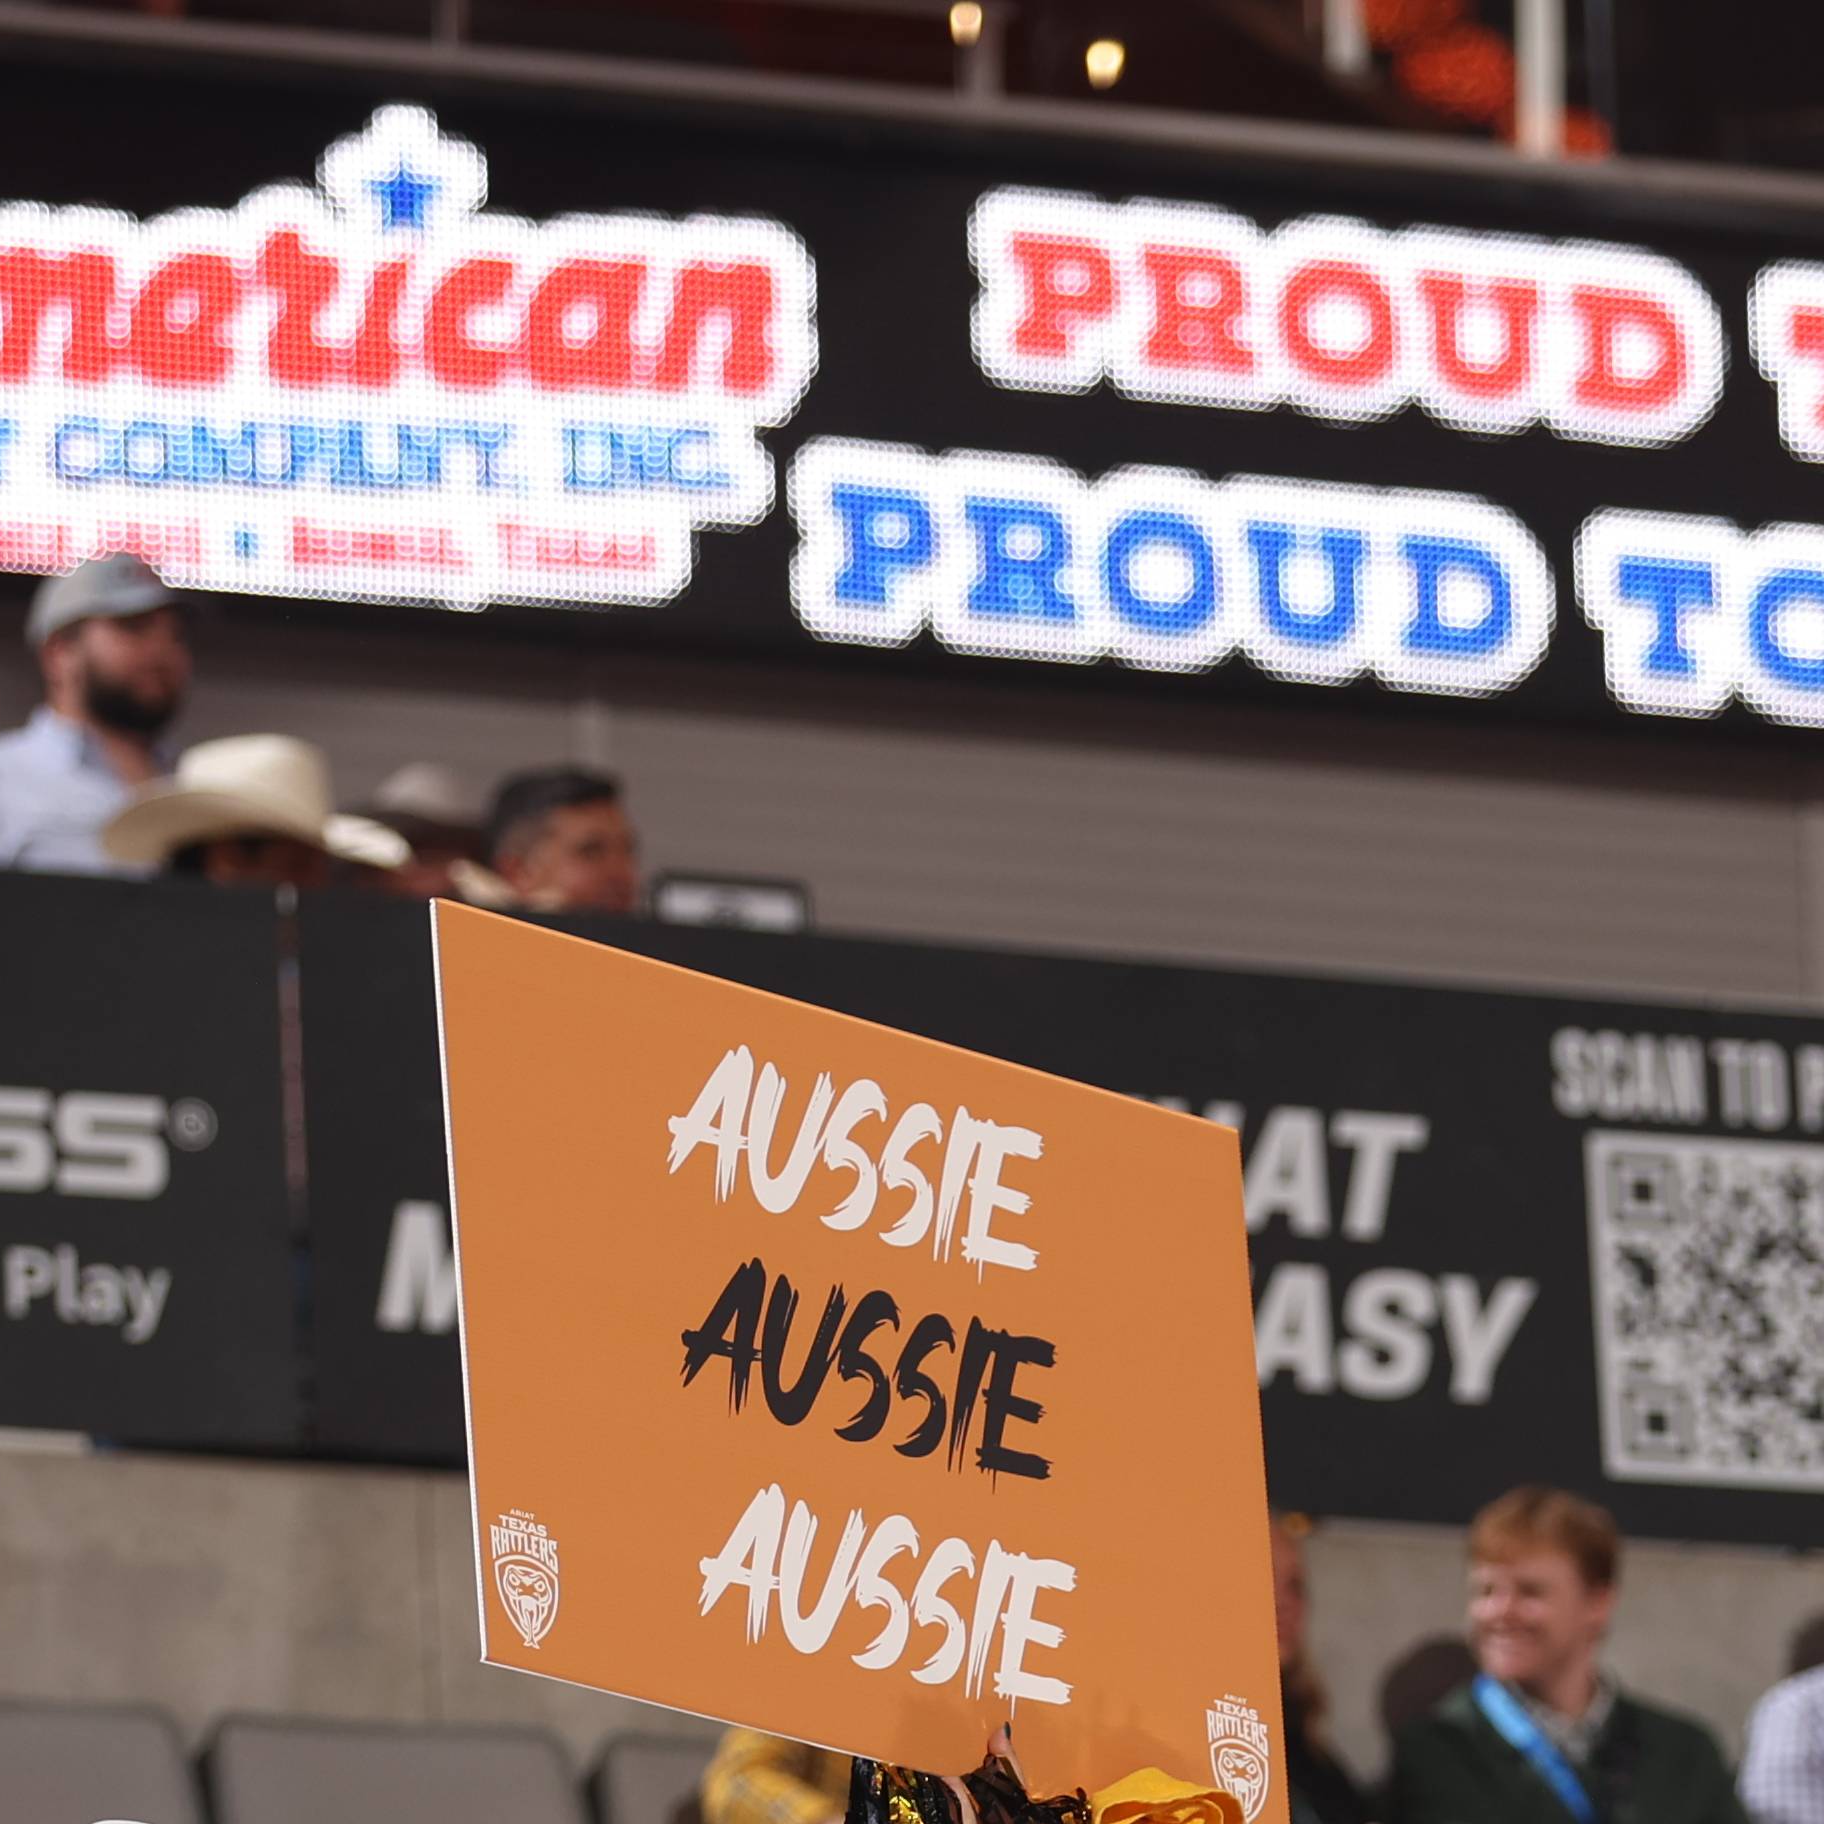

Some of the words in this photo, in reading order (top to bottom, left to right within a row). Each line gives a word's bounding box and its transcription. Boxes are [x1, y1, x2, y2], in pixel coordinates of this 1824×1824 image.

[1012, 232, 1688, 412] PROUD
[831, 483, 1513, 656] PROUD
[1550, 1028, 1705, 1123] SCAN
[1711, 1038, 1789, 1130] TO
[667, 1043, 1046, 1284] AUSSIE
[2, 1247, 169, 1344] Play
[1254, 1261, 1538, 1405] ASY
[680, 1257, 1059, 1495] AUSSIE
[489, 1524, 559, 1575] RATTLERS
[498, 1514, 548, 1538] TEXAS
[698, 1482, 1079, 1720] AUSSIE
[1206, 1708, 1269, 1757] RATTLERS
[1213, 1699, 1259, 1721] TEXAS
